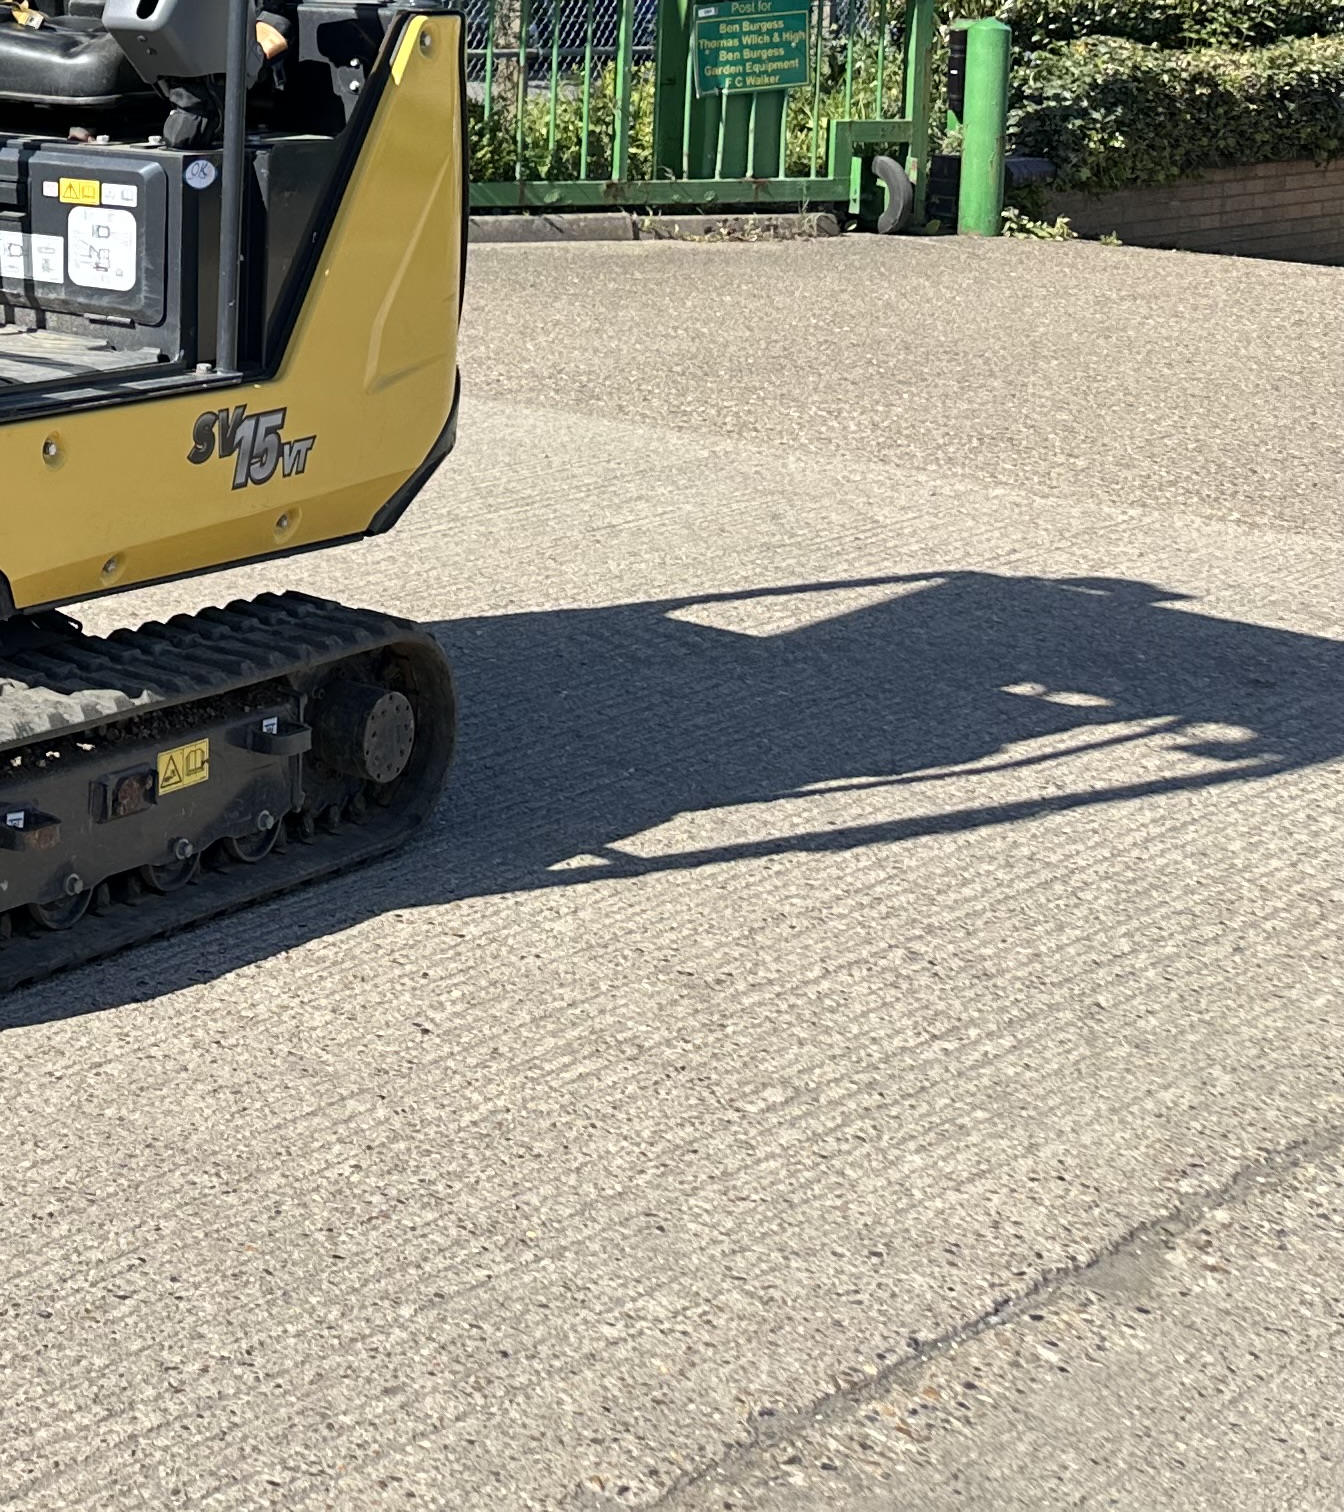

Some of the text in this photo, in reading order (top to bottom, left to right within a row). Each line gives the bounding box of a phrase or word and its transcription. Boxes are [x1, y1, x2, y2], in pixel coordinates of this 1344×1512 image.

[731, 0, 772, 14] Post for
[719, 19, 785, 34] Ben Burgess
[699, 38, 740, 49] Thomas
[773, 32, 780, 43] &
[782, 30, 806, 44] High
[719, 47, 785, 62] Ben Burgess
[704, 58, 800, 76] Garden Equipment
[735, 76, 743, 87] C
[745, 74, 780, 86] Walker
[191, 161, 208, 179] OK
